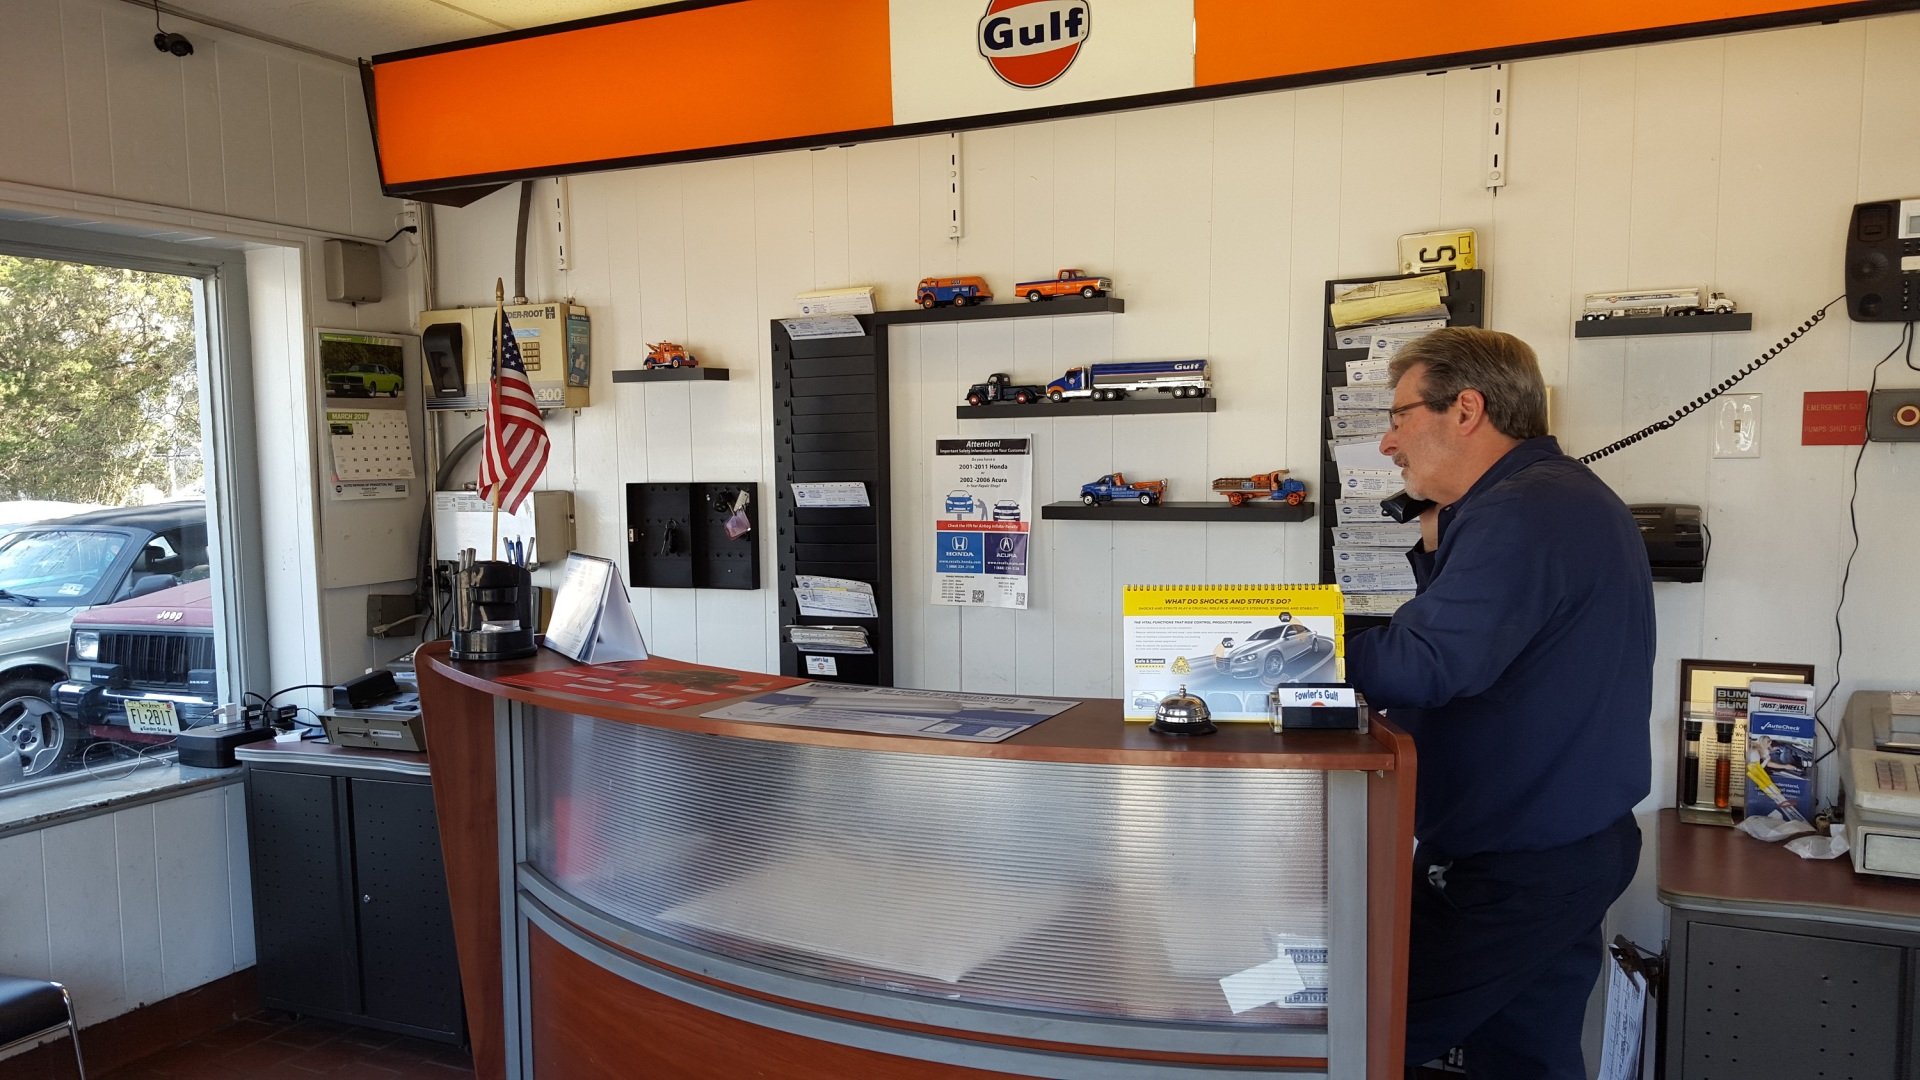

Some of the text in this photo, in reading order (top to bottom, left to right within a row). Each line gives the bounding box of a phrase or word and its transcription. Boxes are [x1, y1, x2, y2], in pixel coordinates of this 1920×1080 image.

[984, 7, 1083, 50] Gulf
[505, 310, 544, 319] DER-ROOT
[1174, 363, 1199, 371] Gulf
[966, 440, 1001, 448] Attention!
[157, 610, 183, 621] Jeep
[1295, 689, 1339, 702] Fowler's Gulf
[1718, 689, 1747, 698] BUM
[1717, 701, 1747, 709] BUM
[1778, 703, 1804, 711] WHEELS
